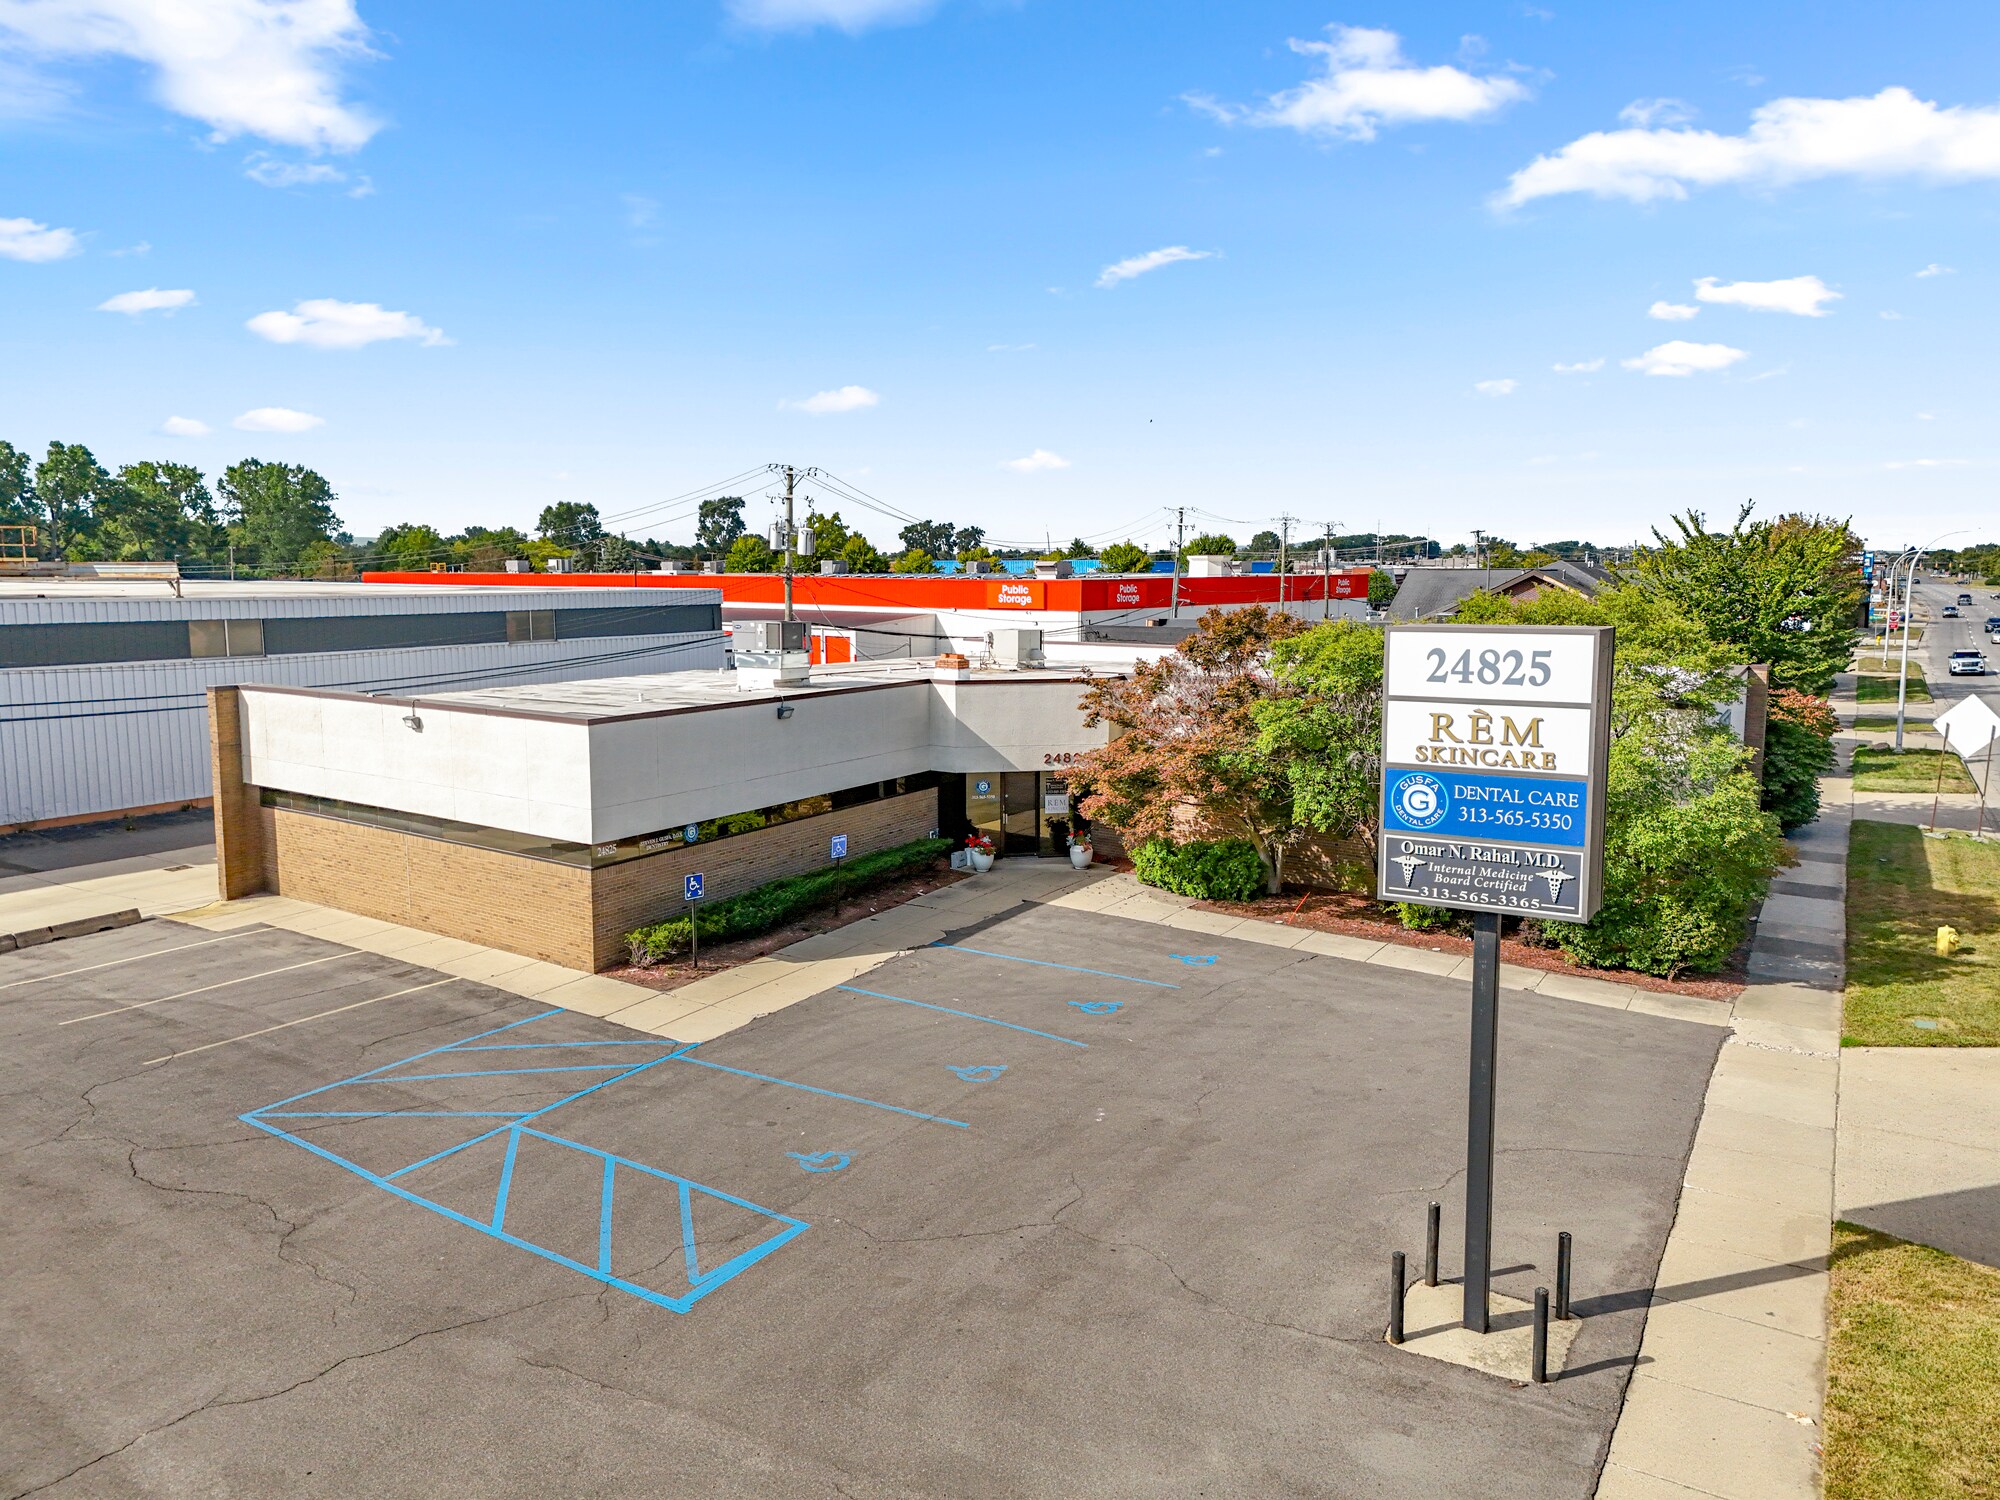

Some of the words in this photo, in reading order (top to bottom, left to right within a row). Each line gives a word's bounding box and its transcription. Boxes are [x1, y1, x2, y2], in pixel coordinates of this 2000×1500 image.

[998, 593, 1032, 606] Storage
[1002, 585, 1029, 595] Public
[1116, 593, 1140, 605] Storage
[1119, 584, 1138, 594] Public
[1336, 586, 1351, 595] Storage
[1426, 647, 1552, 687] 24825
[1429, 708, 1545, 748] RÈM
[1044, 753, 1081, 764] 2482
[1415, 745, 1557, 770] SKINCARE
[1400, 775, 1440, 793] GUSFA
[1408, 789, 1430, 812] G
[1454, 784, 1525, 805] DENTAL
[1528, 790, 1580, 809] CARE
[1395, 804, 1424, 826] DENTAL
[1424, 808, 1444, 825] CARE
[1458, 806, 1572, 831] 313-565-5350
[597, 843, 617, 857] 24825
[1401, 840, 1446, 858] Omar
[1449, 844, 1467, 860] N.
[1470, 846, 1521, 868] Rahal,
[1524, 851, 1565, 869] M.D.
[1428, 861, 1476, 876] Internal
[1478, 866, 1534, 882] Medicine
[1434, 873, 1471, 886] Board
[1474, 876, 1527, 893] Certified
[1420, 886, 1540, 909] 313-565-3365
